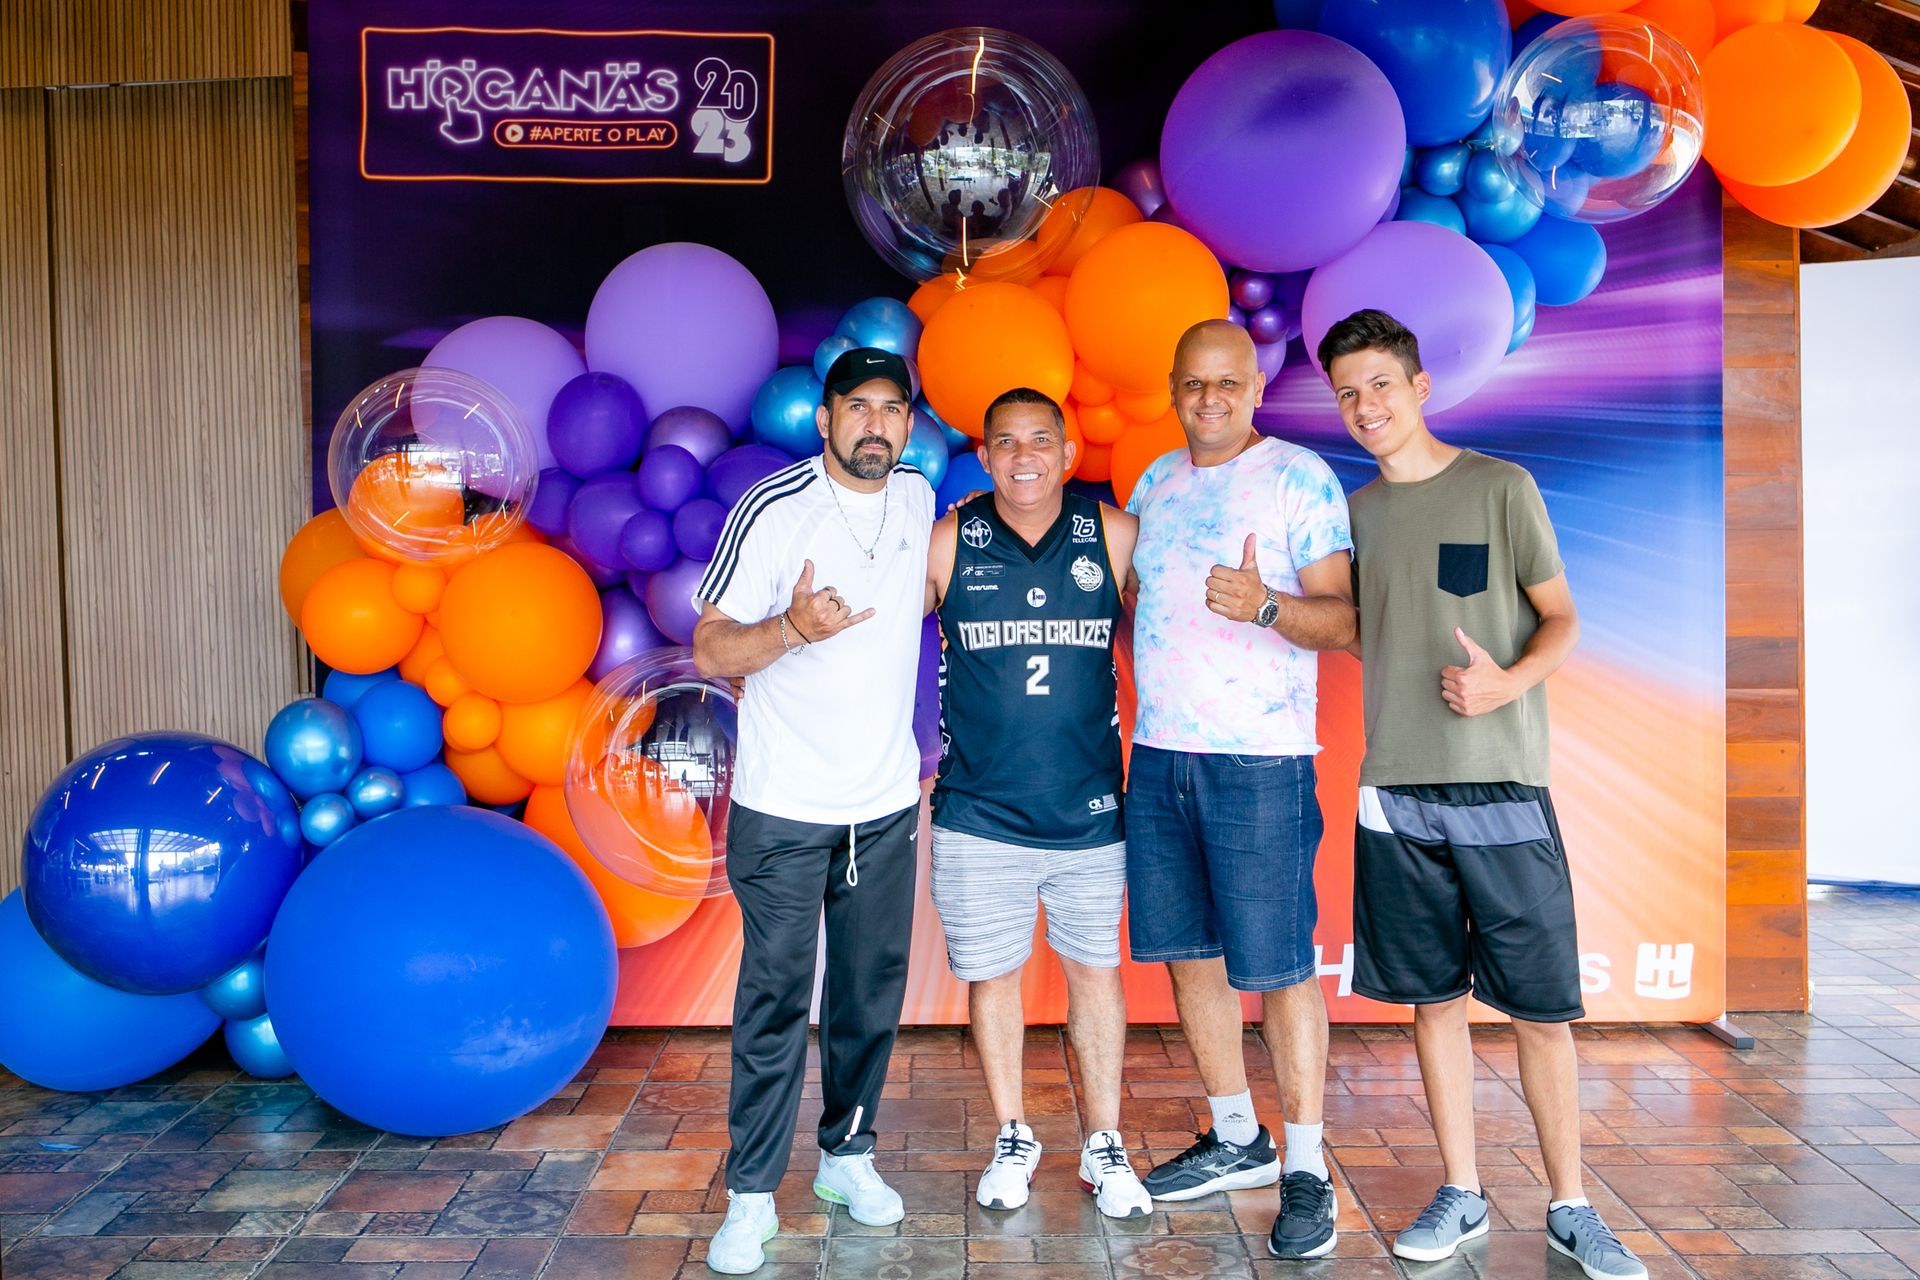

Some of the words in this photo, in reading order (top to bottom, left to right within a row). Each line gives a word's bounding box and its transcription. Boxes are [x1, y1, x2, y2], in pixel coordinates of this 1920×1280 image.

[529, 126, 602, 143] #APERTE
[607, 127, 622, 142] O
[626, 127, 667, 142] PLAY
[957, 620, 1001, 651] MOGI
[1002, 619, 1043, 646] DAS
[1044, 617, 1113, 650] CRUZES
[1025, 654, 1050, 696] 2
